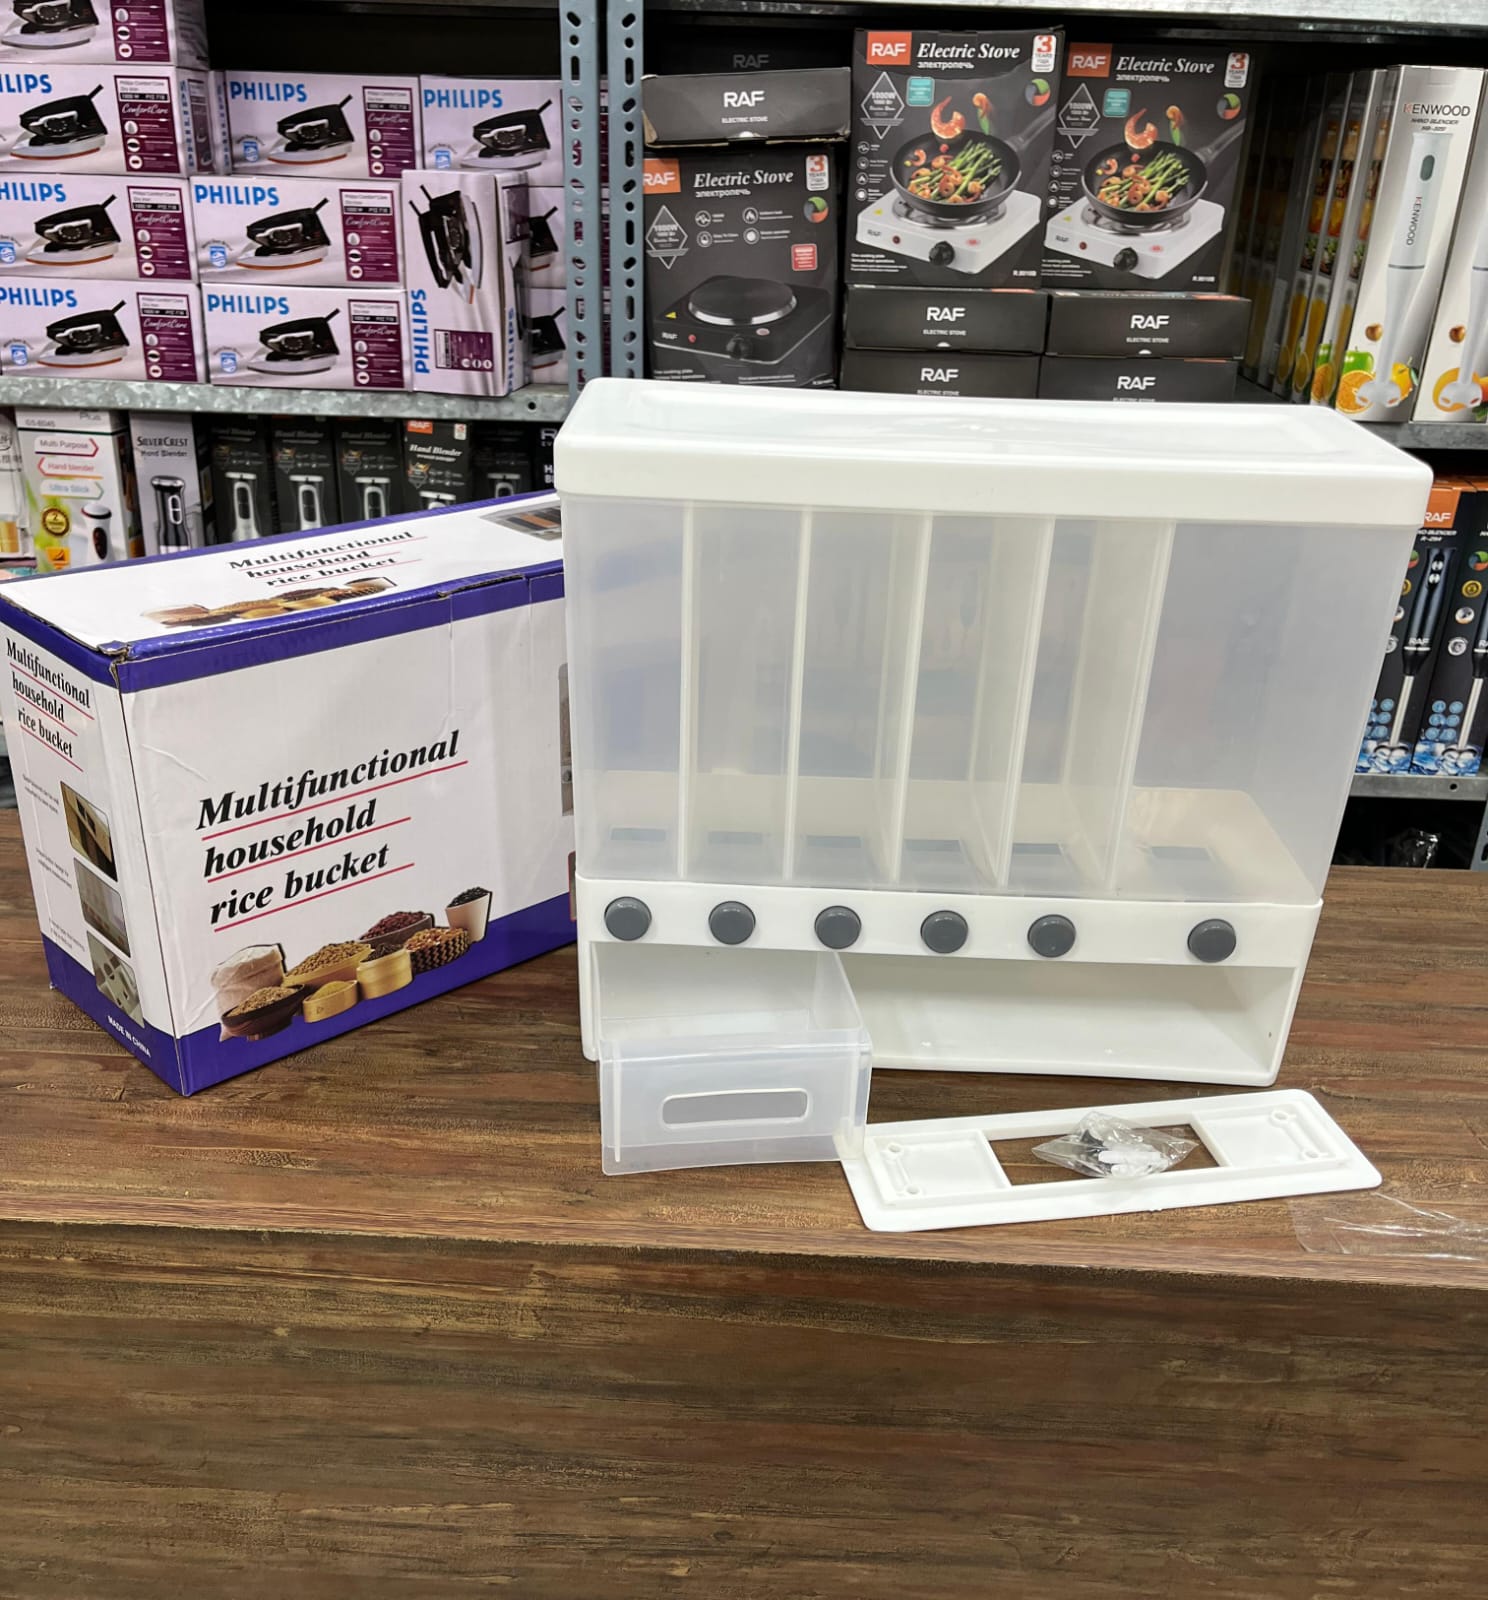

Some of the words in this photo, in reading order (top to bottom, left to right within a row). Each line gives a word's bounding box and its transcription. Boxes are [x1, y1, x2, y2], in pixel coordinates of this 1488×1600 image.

[872, 43, 907, 57] RAF
[917, 43, 974, 58] Electric
[978, 43, 1020, 58] Stove
[1037, 36, 1053, 52] 3
[733, 54, 769, 68] RAF
[1072, 55, 1107, 69] RAF
[1116, 57, 1171, 71] Electric
[1175, 58, 1215, 73] Stove
[1231, 53, 1246, 69] 3
[230, 81, 307, 102] PHILIPS
[424, 89, 503, 108] PHILIPS
[724, 90, 765, 107] RAF
[1403, 103, 1471, 117] KENWOOD
[810, 155, 825, 172] 3
[643, 172, 676, 186] RAF
[694, 172, 750, 188] Electric
[754, 169, 794, 185] Stove
[194, 184, 279, 206] PHILIPS
[1406, 196, 1423, 246] KENWOOD
[207, 294, 289, 315] PHILIPS
[927, 307, 965, 321] RAF
[1130, 315, 1170, 329] RAF
[411, 289, 430, 374] PHILIPS
[921, 368, 959, 382] RAF
[1117, 376, 1156, 390] RAF
[60, 440, 89, 450] Purpose
[409, 444, 431, 453] Hand
[433, 445, 462, 457] Blender
[1424, 512, 1451, 523] RAF
[229, 531, 414, 569] Multifunctional
[247, 550, 370, 579] household
[266, 571, 308, 587] rice
[319, 557, 397, 577] bucket
[6, 638, 91, 708] Multifunctional
[12, 671, 65, 723] household
[18, 707, 37, 732] rice
[38, 718, 73, 758] bucket
[196, 729, 460, 830] Multifunctional
[204, 798, 377, 878] household
[210, 886, 274, 925] rice
[284, 844, 390, 900] bucket
[107, 1014, 125, 1038] MADE
[125, 1031, 132, 1044] IN
[132, 1037, 151, 1058] CHINA
